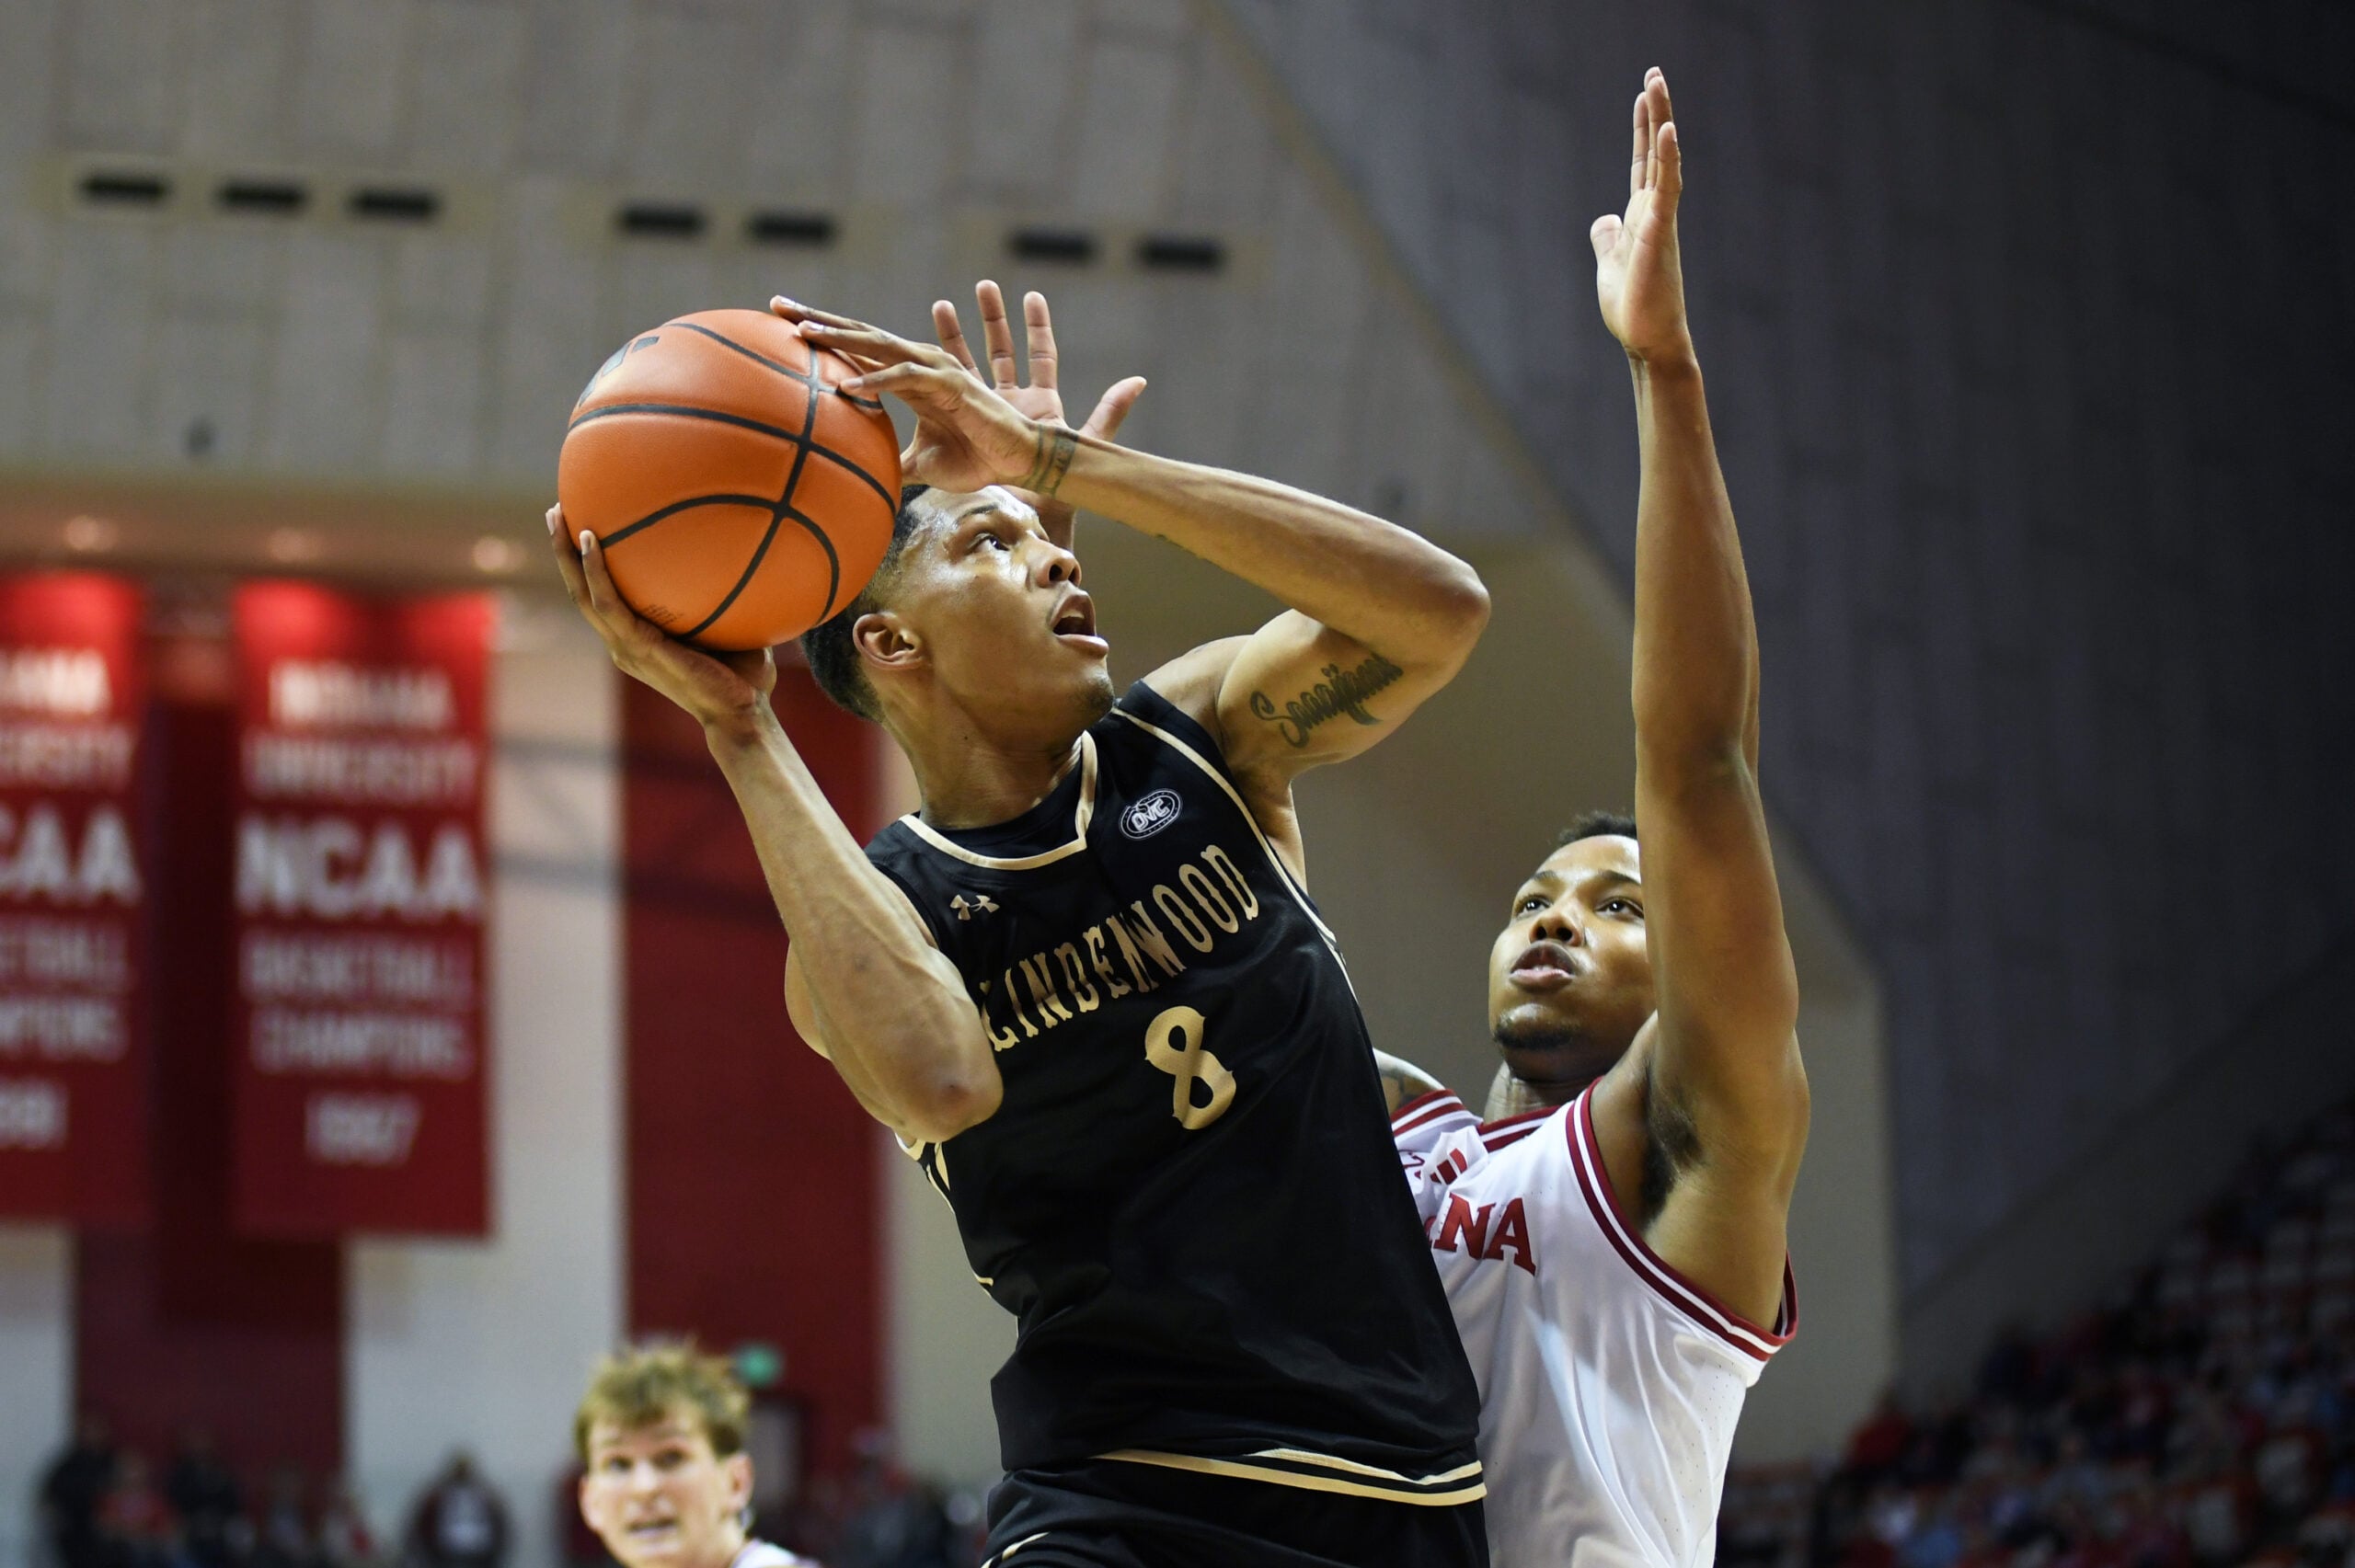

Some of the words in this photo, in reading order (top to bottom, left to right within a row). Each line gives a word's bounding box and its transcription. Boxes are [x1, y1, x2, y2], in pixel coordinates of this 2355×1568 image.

[236, 814, 485, 920] NCAA
[1144, 1005, 1237, 1131] 8
[1425, 1192, 1536, 1276] NA
